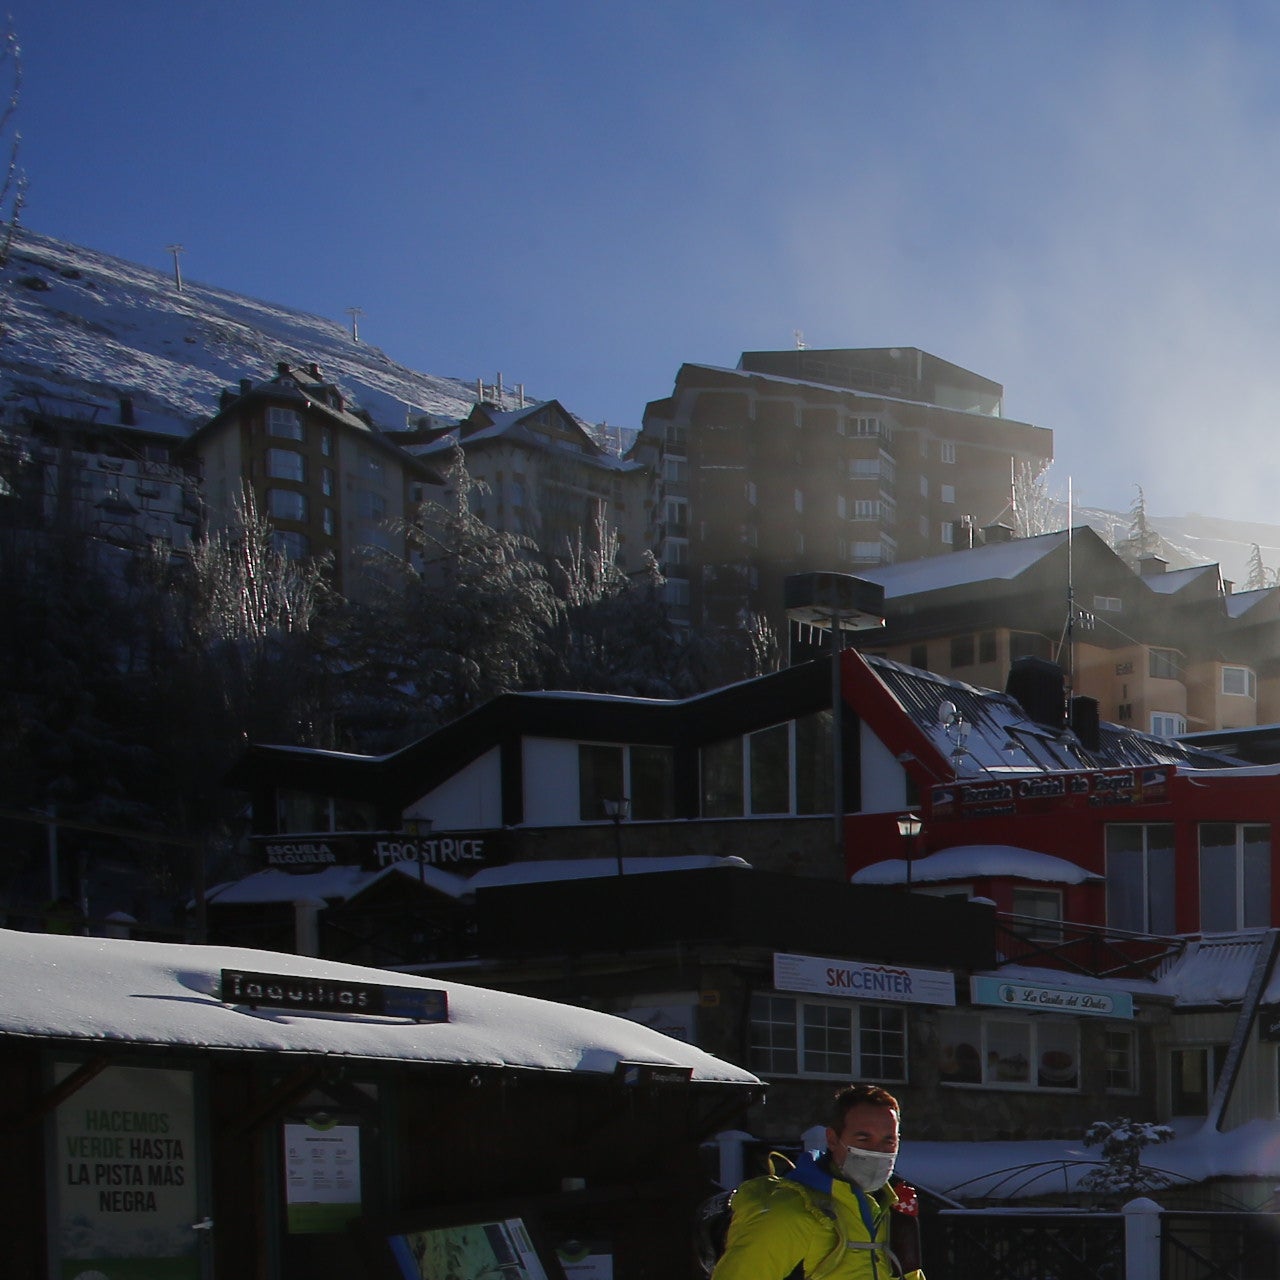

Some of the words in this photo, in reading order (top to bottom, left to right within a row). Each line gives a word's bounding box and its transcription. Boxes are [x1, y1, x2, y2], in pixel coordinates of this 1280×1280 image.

[86, 1109, 170, 1134] HACEMOS
[66, 1136, 125, 1159] VERDE
[130, 1138, 185, 1161] HASTA
[68, 1163, 91, 1186] LA
[95, 1163, 144, 1187] PISTA
[148, 1160, 185, 1187] MÁS
[99, 1190, 157, 1213] NEGRA
